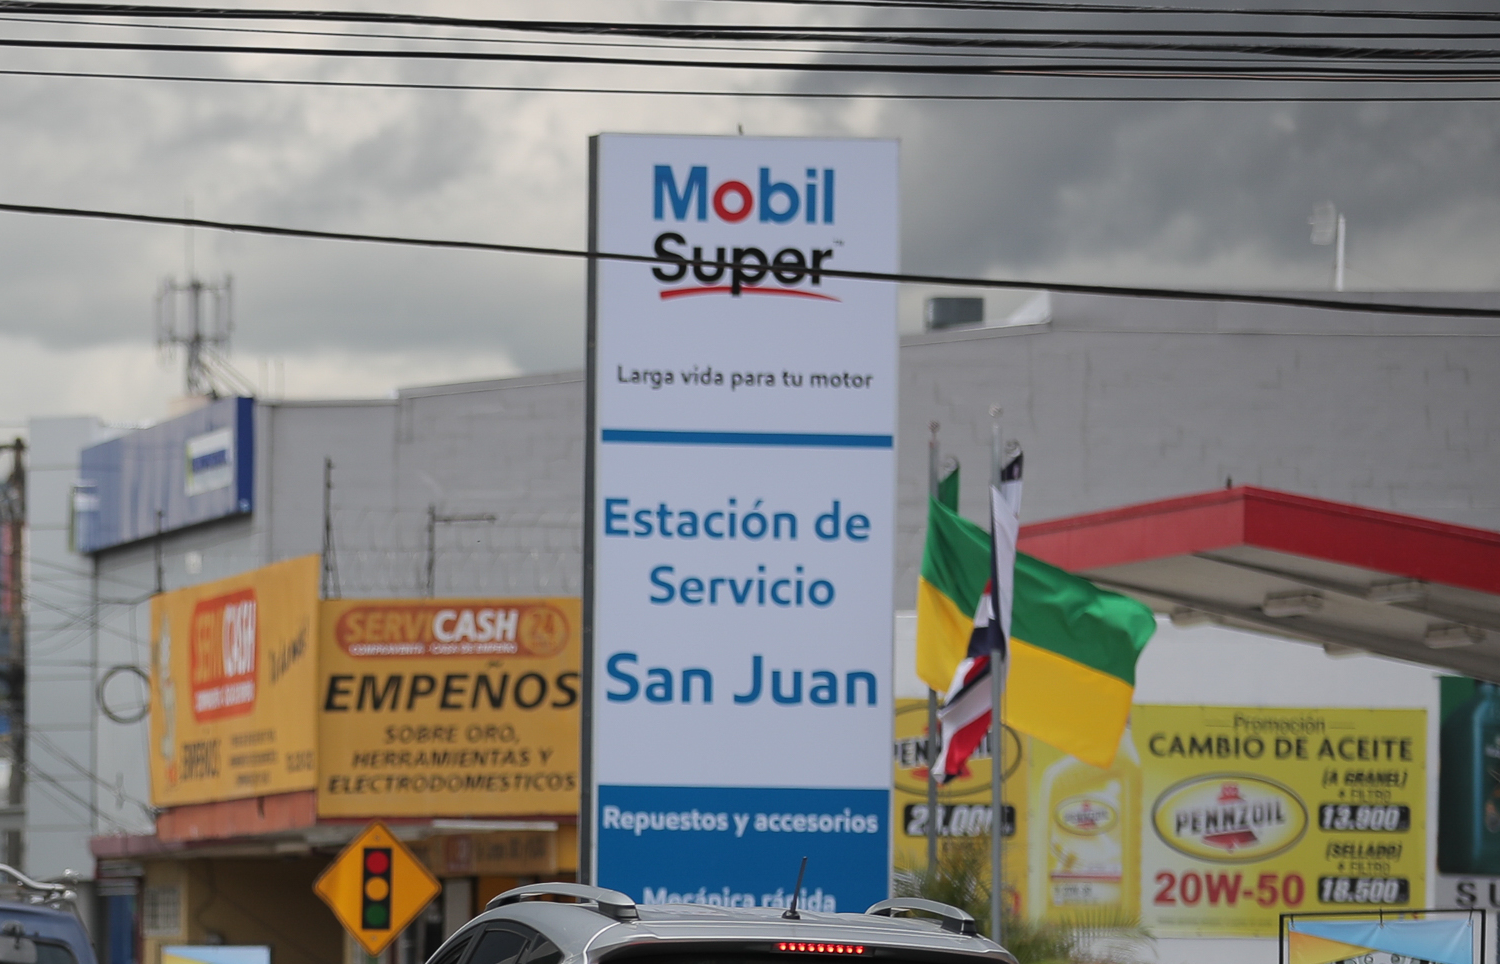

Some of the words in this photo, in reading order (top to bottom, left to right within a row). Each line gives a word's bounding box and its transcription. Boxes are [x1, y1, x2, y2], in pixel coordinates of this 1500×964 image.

[653, 165, 835, 225] Mobil
[651, 232, 834, 297] Super
[617, 365, 674, 389] Larga
[681, 365, 723, 386] vida
[731, 371, 776, 391] para
[782, 370, 802, 387] tu
[810, 371, 873, 389] motor
[604, 497, 798, 540] Estación
[814, 500, 871, 541] de
[649, 564, 836, 607] Servicio
[323, 661, 580, 712] EMPEÑOS
[605, 652, 713, 703] San
[733, 655, 878, 707] Juan
[385, 724, 458, 743] SOBRE
[1234, 714, 1325, 736] Promoción
[354, 751, 530, 768] HERRAMIENTAS
[538, 751, 553, 766] Y
[1149, 733, 1265, 759] CAMBIO
[1275, 737, 1309, 760] DE
[1318, 737, 1414, 762] ACEITE
[328, 774, 577, 794] ELECTRODOMESTICOS
[602, 805, 729, 836] Repuestos
[733, 812, 750, 838] y
[754, 807, 879, 834] accesorios
[1175, 801, 1286, 836] PENNZOIL
[1153, 872, 1306, 908] 20W-50
